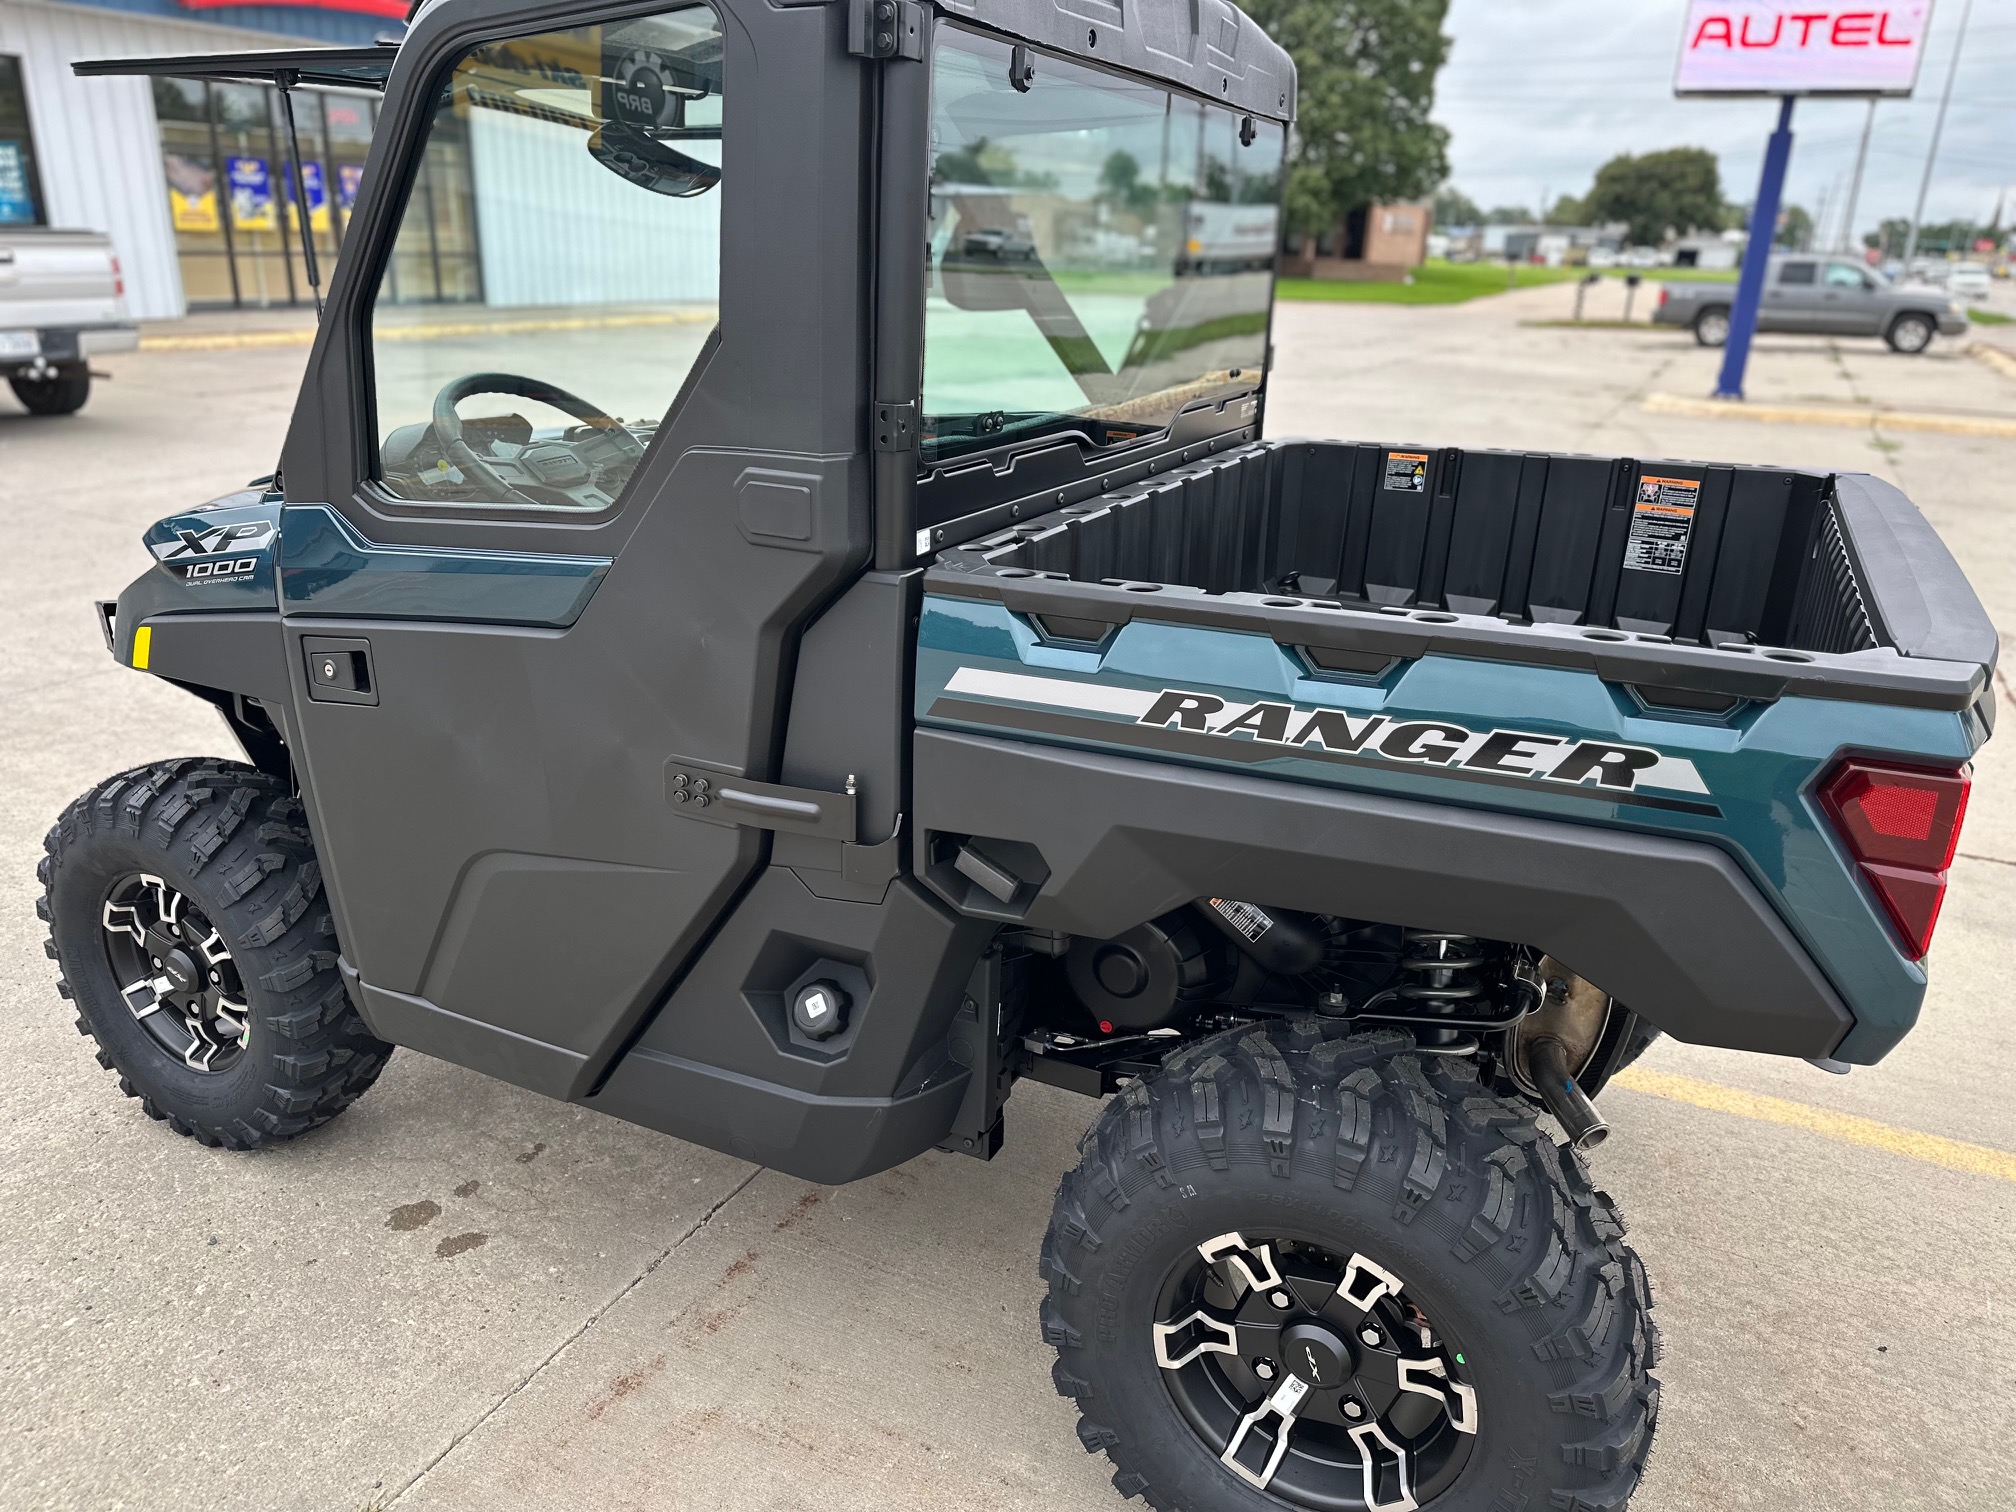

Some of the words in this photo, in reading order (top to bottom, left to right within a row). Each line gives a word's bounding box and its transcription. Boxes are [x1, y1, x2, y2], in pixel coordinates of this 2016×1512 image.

[1691, 12, 1912, 49] AUTEL
[163, 521, 272, 559] XP
[185, 557, 258, 579] 1000
[203, 576, 238, 585] OVERHEAD
[1136, 688, 1662, 791] RANGER
